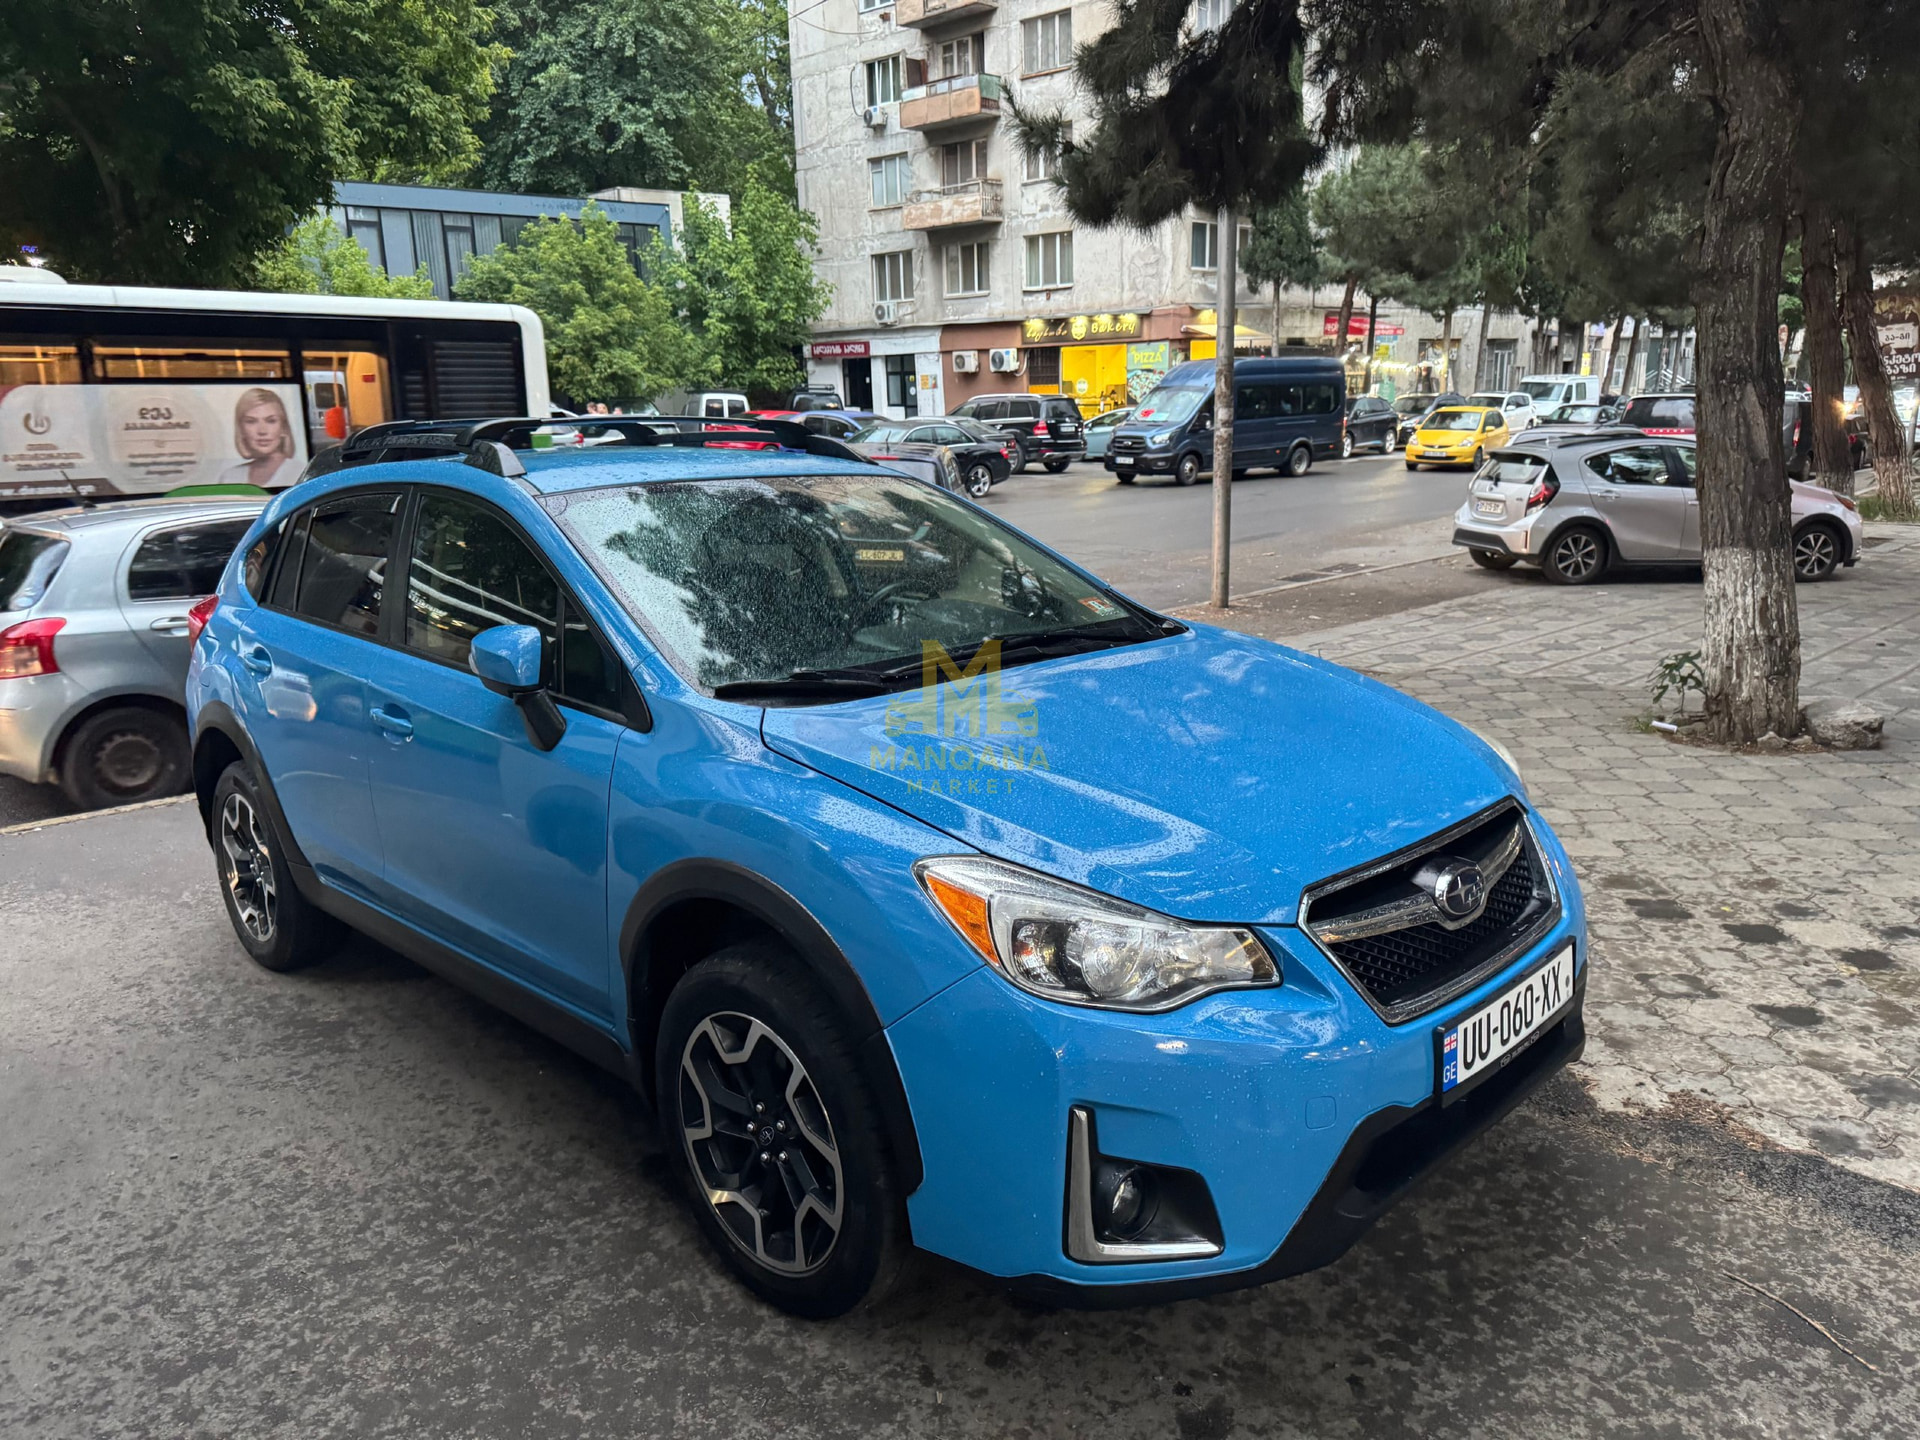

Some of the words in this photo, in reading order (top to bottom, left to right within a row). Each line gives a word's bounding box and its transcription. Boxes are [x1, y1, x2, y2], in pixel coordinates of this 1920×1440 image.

[1133, 351, 1162, 363] PIZZA
[1463, 961, 1561, 1070] UU-060-XX
[1443, 1060, 1456, 1083] GE
